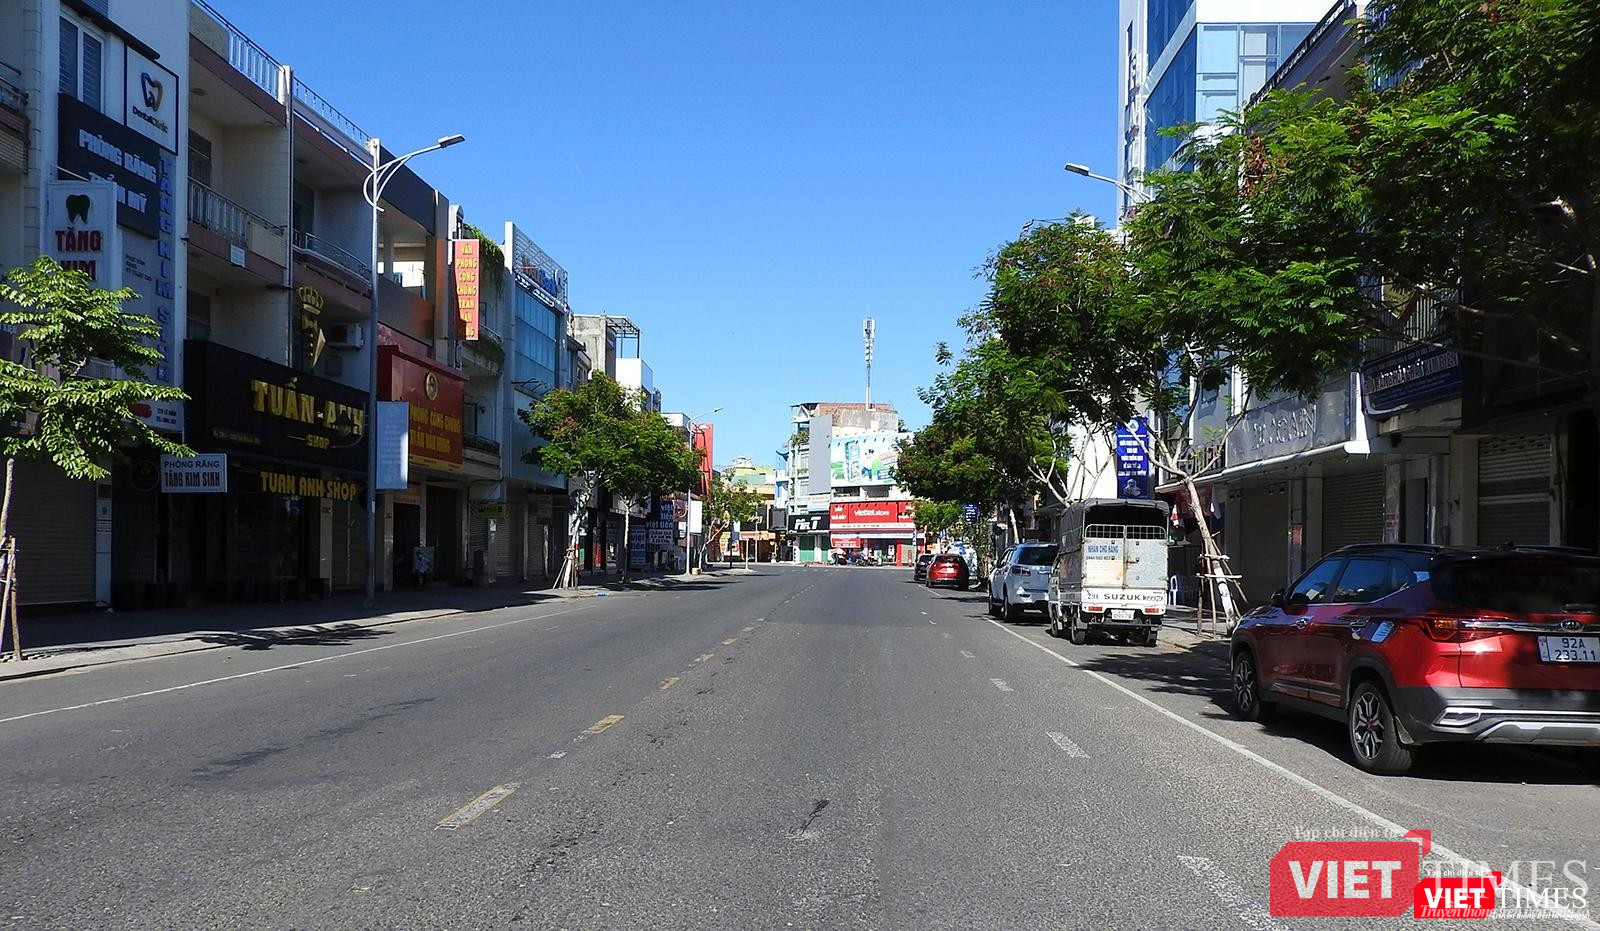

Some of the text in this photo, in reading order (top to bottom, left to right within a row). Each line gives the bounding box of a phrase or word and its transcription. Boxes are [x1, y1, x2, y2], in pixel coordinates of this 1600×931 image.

[78, 127, 122, 167] PHÒNG
[55, 225, 103, 252] TĂNG
[306, 434, 330, 449] SHOP
[165, 470, 220, 487] TĂNG KIM SINH
[260, 471, 296, 495] TUAN
[326, 481, 357, 501] SHOP
[1561, 637, 1586, 649] 92A
[1554, 649, 1596, 661] 233.11
